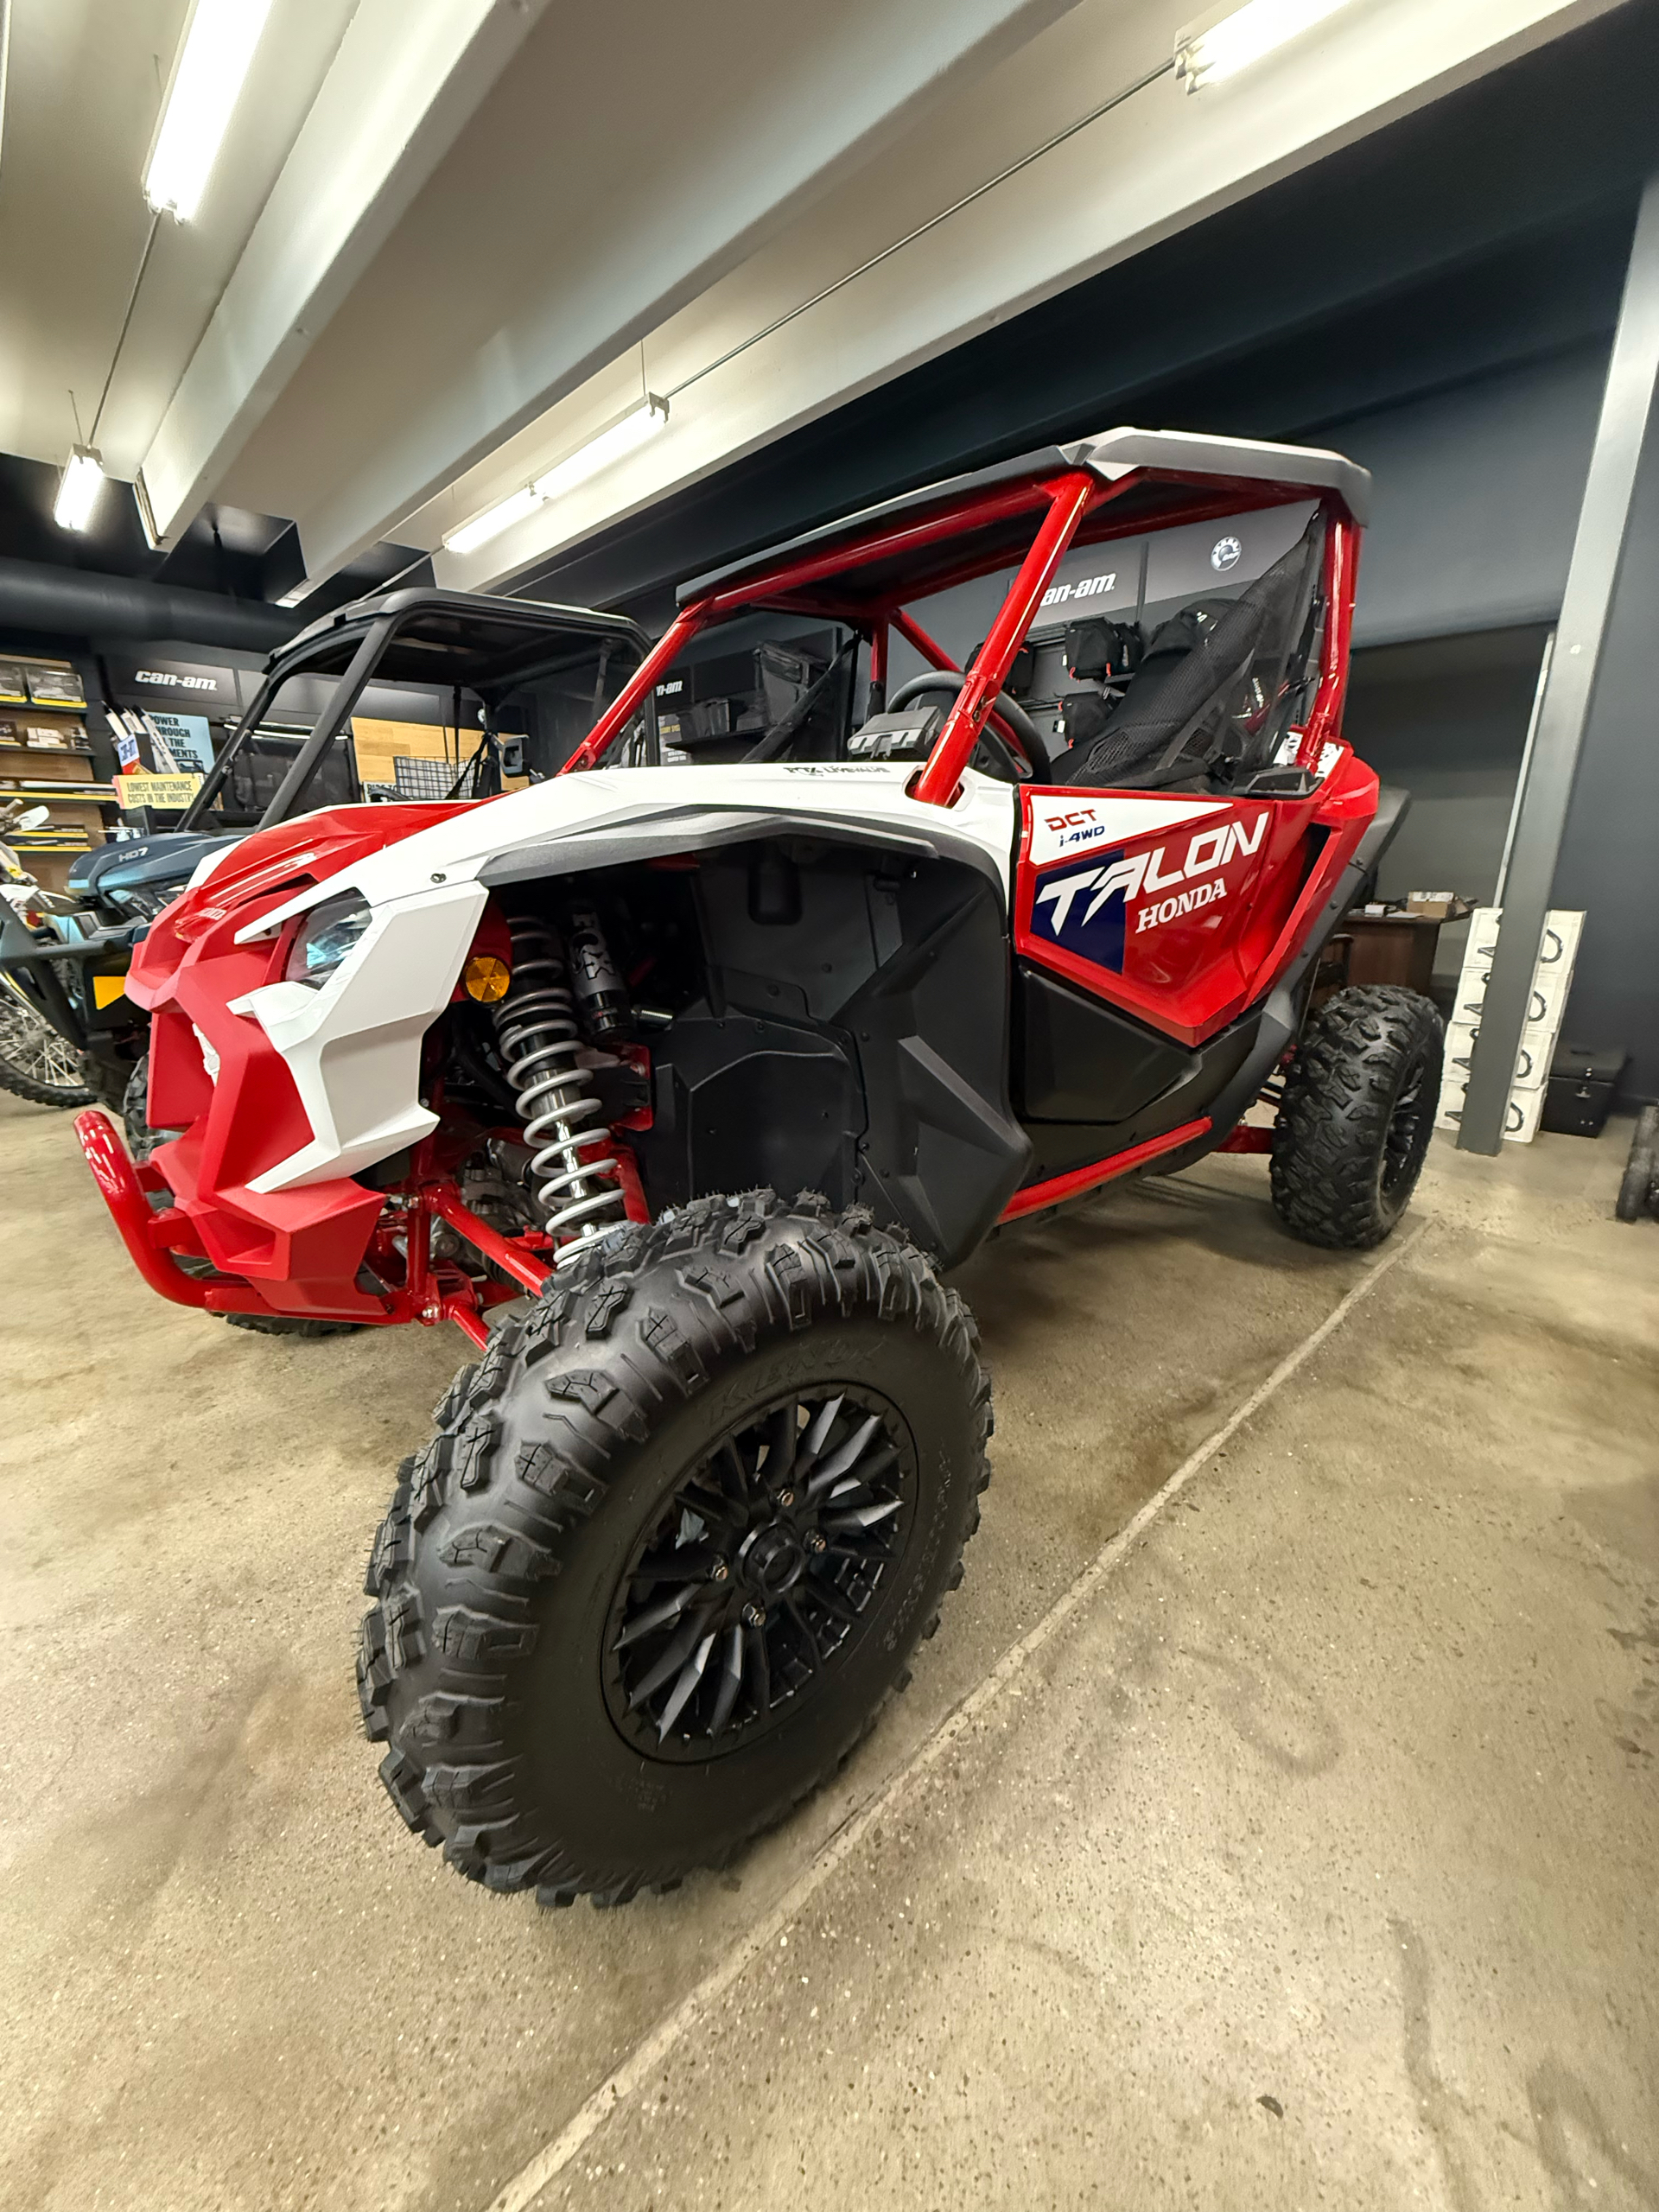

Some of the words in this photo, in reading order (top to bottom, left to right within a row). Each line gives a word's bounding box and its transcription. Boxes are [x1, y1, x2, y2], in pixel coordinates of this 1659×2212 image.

[1040, 573, 1115, 607] an-am
[135, 671, 217, 690] can-am
[168, 737, 187, 748] THE
[127, 782, 149, 791] LOWEST
[150, 780, 193, 791] MAINTENANCE
[128, 793, 146, 803] COSTS
[147, 793, 154, 803] IN
[154, 793, 166, 803] THE
[1044, 809, 1097, 832] DCT
[1059, 825, 1105, 848] i-4WD
[1035, 811, 1269, 937] TALON
[1135, 877, 1228, 935] HONDA
